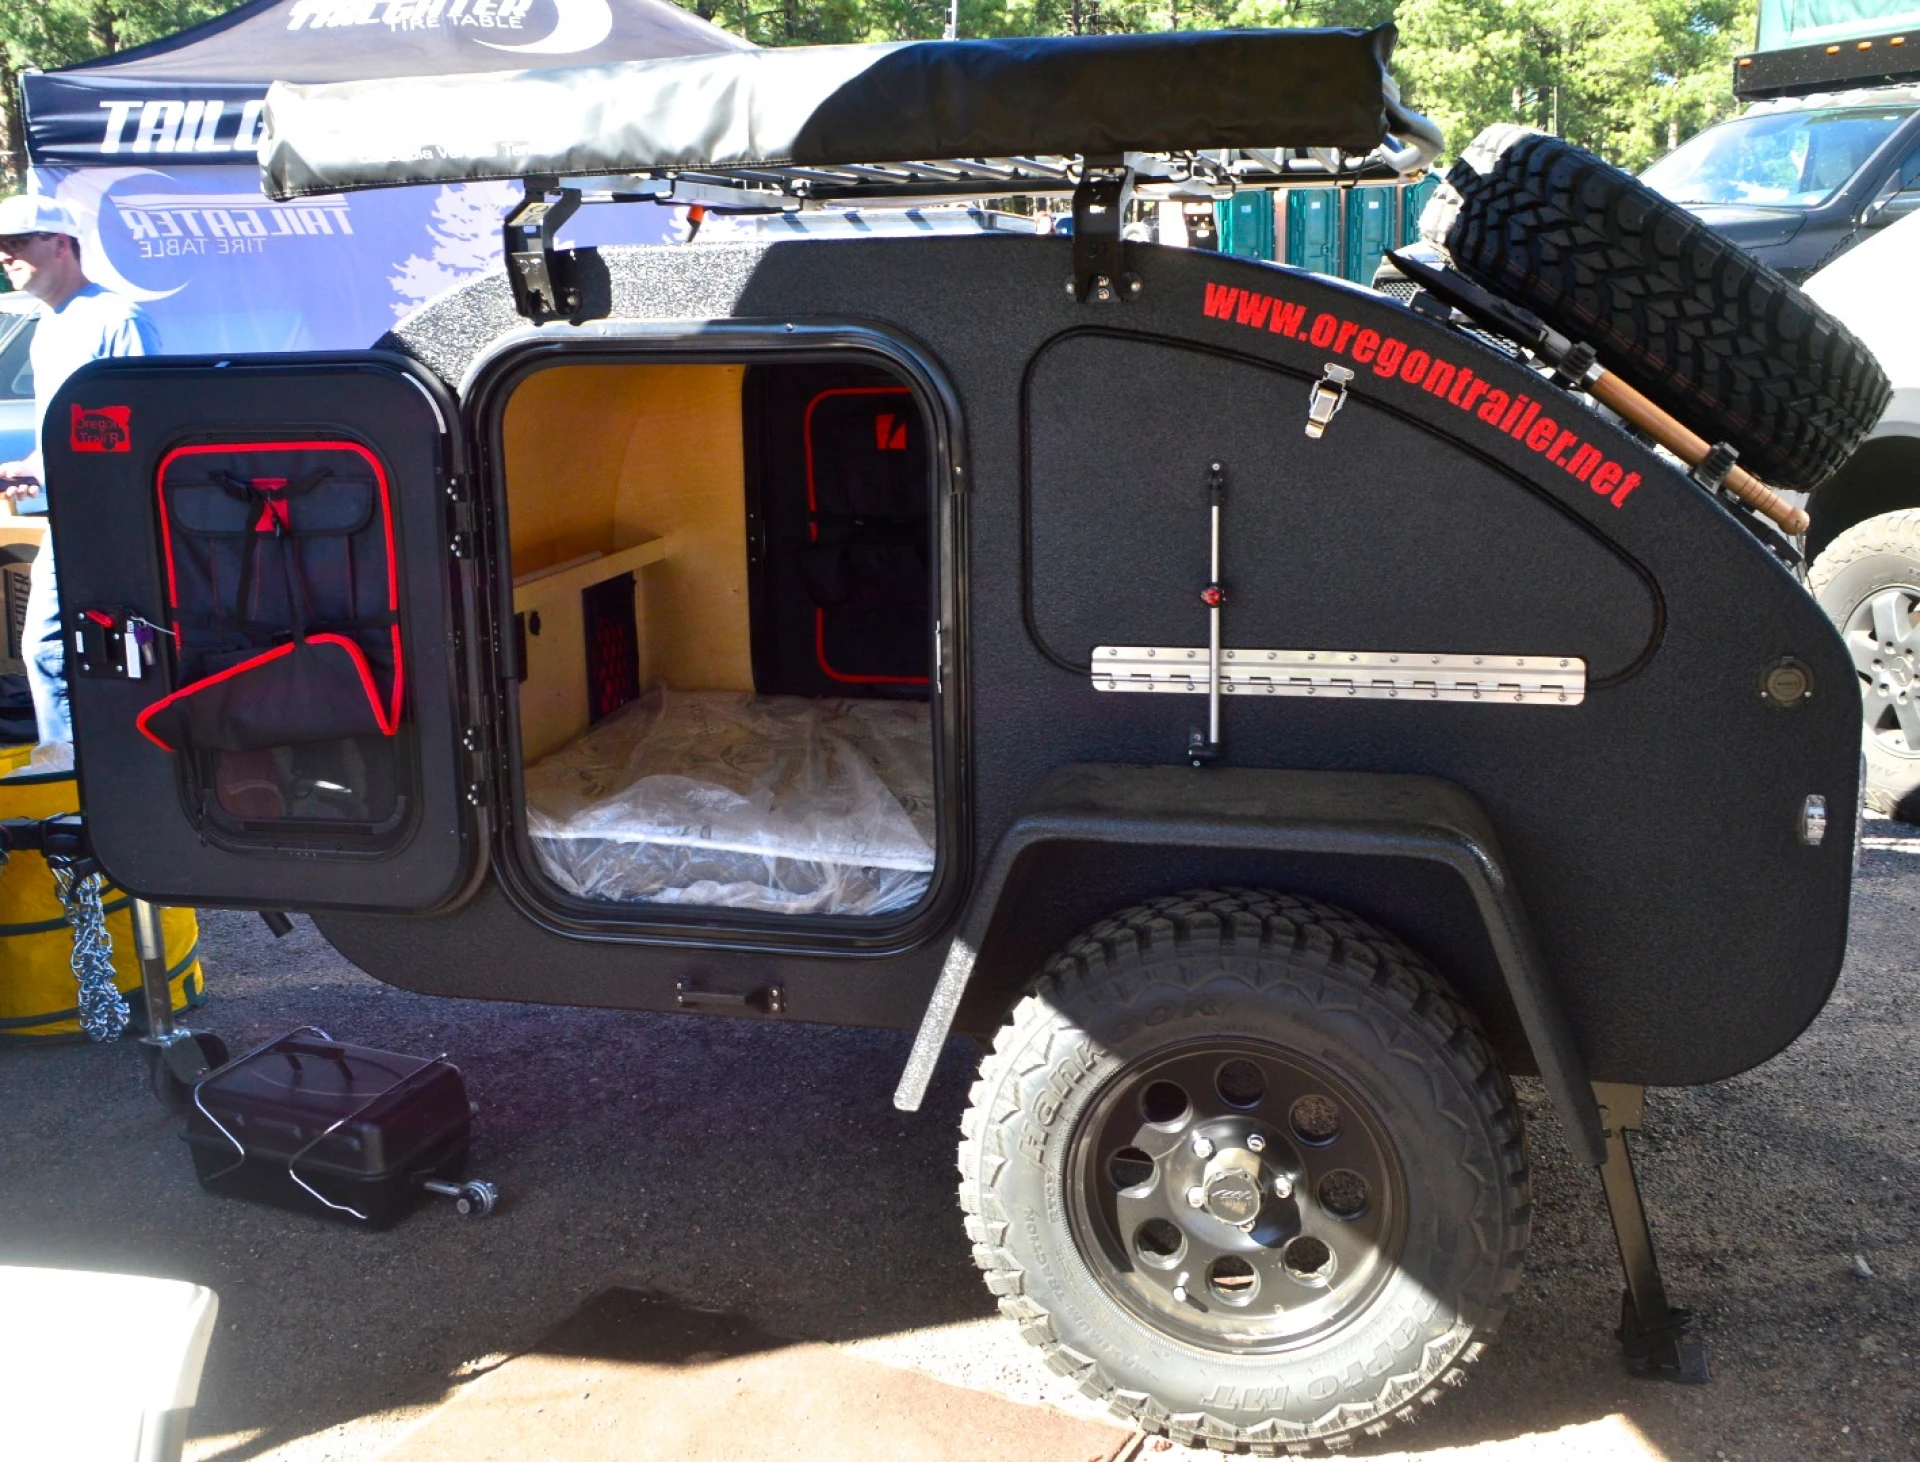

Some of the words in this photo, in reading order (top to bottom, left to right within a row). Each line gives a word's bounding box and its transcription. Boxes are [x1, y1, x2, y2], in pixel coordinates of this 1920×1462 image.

[389, 15, 440, 32] TIRE
[446, 14, 524, 30] TABLE
[1203, 281, 1642, 509] www.oregontrailer.net
